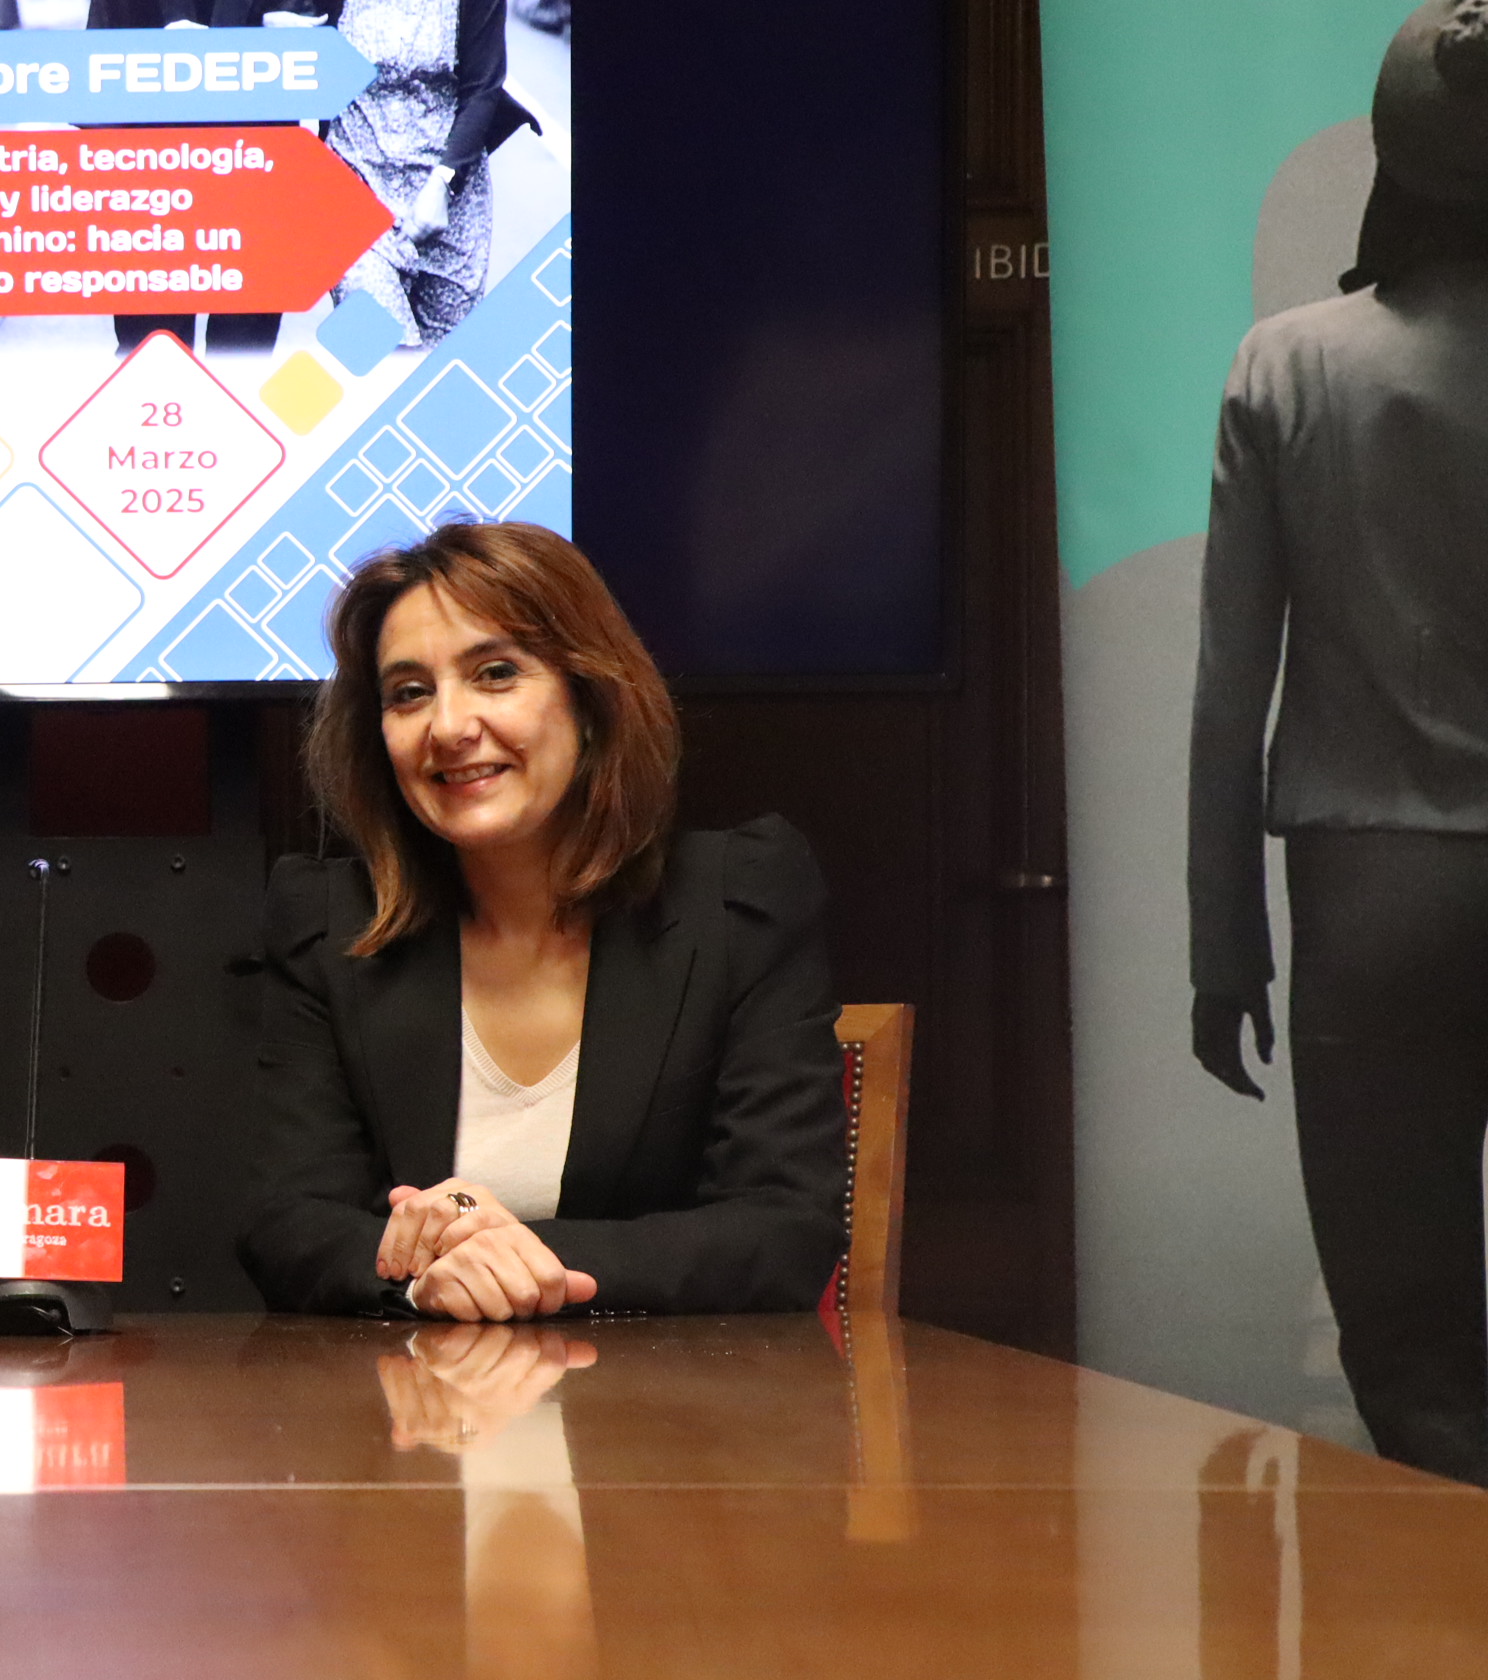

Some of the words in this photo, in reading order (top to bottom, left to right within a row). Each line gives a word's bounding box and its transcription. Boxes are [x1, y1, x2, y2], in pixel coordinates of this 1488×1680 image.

[88, 50, 319, 93] FEDEPE
[79, 138, 274, 175] tecnología,
[31, 184, 194, 216] liderazgo
[87, 223, 185, 252] hacia
[195, 228, 242, 251] un
[24, 263, 244, 298] responsable
[141, 402, 183, 427] 28
[108, 445, 218, 470] Marzo
[120, 488, 205, 514] 2025
